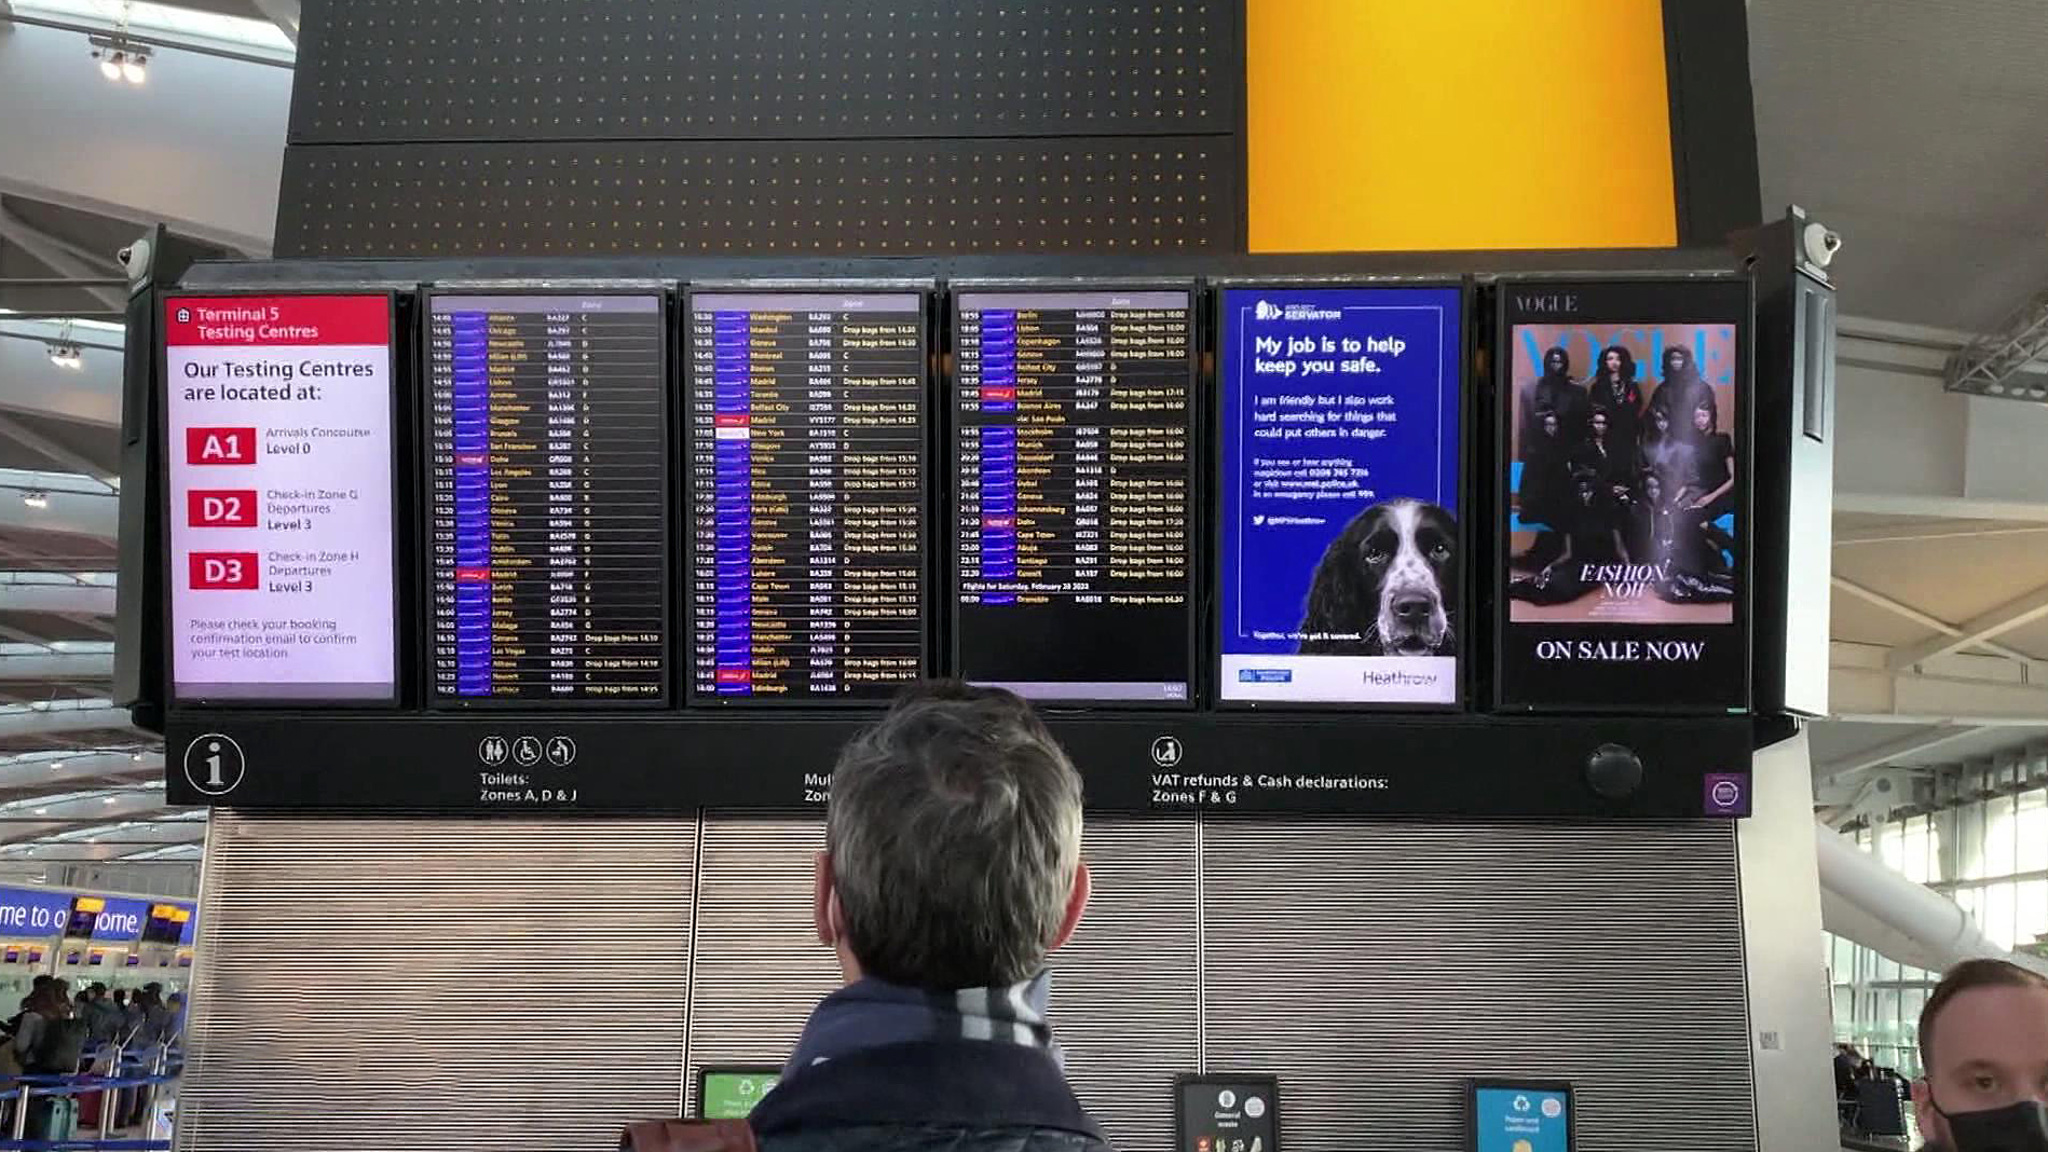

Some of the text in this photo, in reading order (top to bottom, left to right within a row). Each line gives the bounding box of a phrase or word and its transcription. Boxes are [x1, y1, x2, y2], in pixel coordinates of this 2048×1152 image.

[1515, 295, 1578, 312] VOGUE
[197, 307, 280, 320] Terminal 5
[197, 325, 319, 341] Testing Centres
[1255, 335, 1406, 357] My job is to help
[184, 361, 374, 380] Our Testing Centres
[1255, 356, 1381, 377] keep you safe.
[184, 384, 322, 400] are located at:
[1261, 396, 1276, 405] am
[1279, 395, 1316, 407] friendly
[1318, 395, 1336, 405] but
[1344, 395, 1366, 406] also
[1367, 395, 1395, 405] work
[1254, 411, 1397, 424] hard searching for things that
[266, 428, 371, 438] Arrivals Concourse
[1254, 427, 1282, 438] could
[1285, 427, 1302, 440] put
[1304, 427, 1337, 438] others
[1339, 427, 1349, 438] in
[201, 434, 242, 459] A1
[266, 442, 311, 454] Level 0
[267, 490, 316, 500] Check-in
[318, 490, 347, 500] Zone
[203, 497, 242, 521] D2
[267, 504, 332, 516] Departures
[267, 519, 312, 531] Level 3
[268, 551, 359, 562] Check-in Zone H
[204, 559, 243, 583] D3
[269, 566, 332, 577] Departures
[1579, 564, 1667, 582] FASHION
[269, 580, 313, 593] Level 3
[190, 619, 337, 633] Please check your booking
[190, 634, 357, 645] confirmation email to confirm
[190, 647, 289, 660] your test location
[1536, 640, 1705, 660] ON SALE NOW
[1363, 671, 1437, 685] Heathrow
[480, 773, 529, 786] Toilets:
[1152, 774, 1389, 789] VAT refunds & Cash declarations:
[480, 789, 578, 804] Zones A, D & J
[804, 789, 832, 803] Zon
[1152, 790, 1237, 804] Zones F & G
[31, 905, 49, 927] to
[94, 912, 139, 933] ome.
